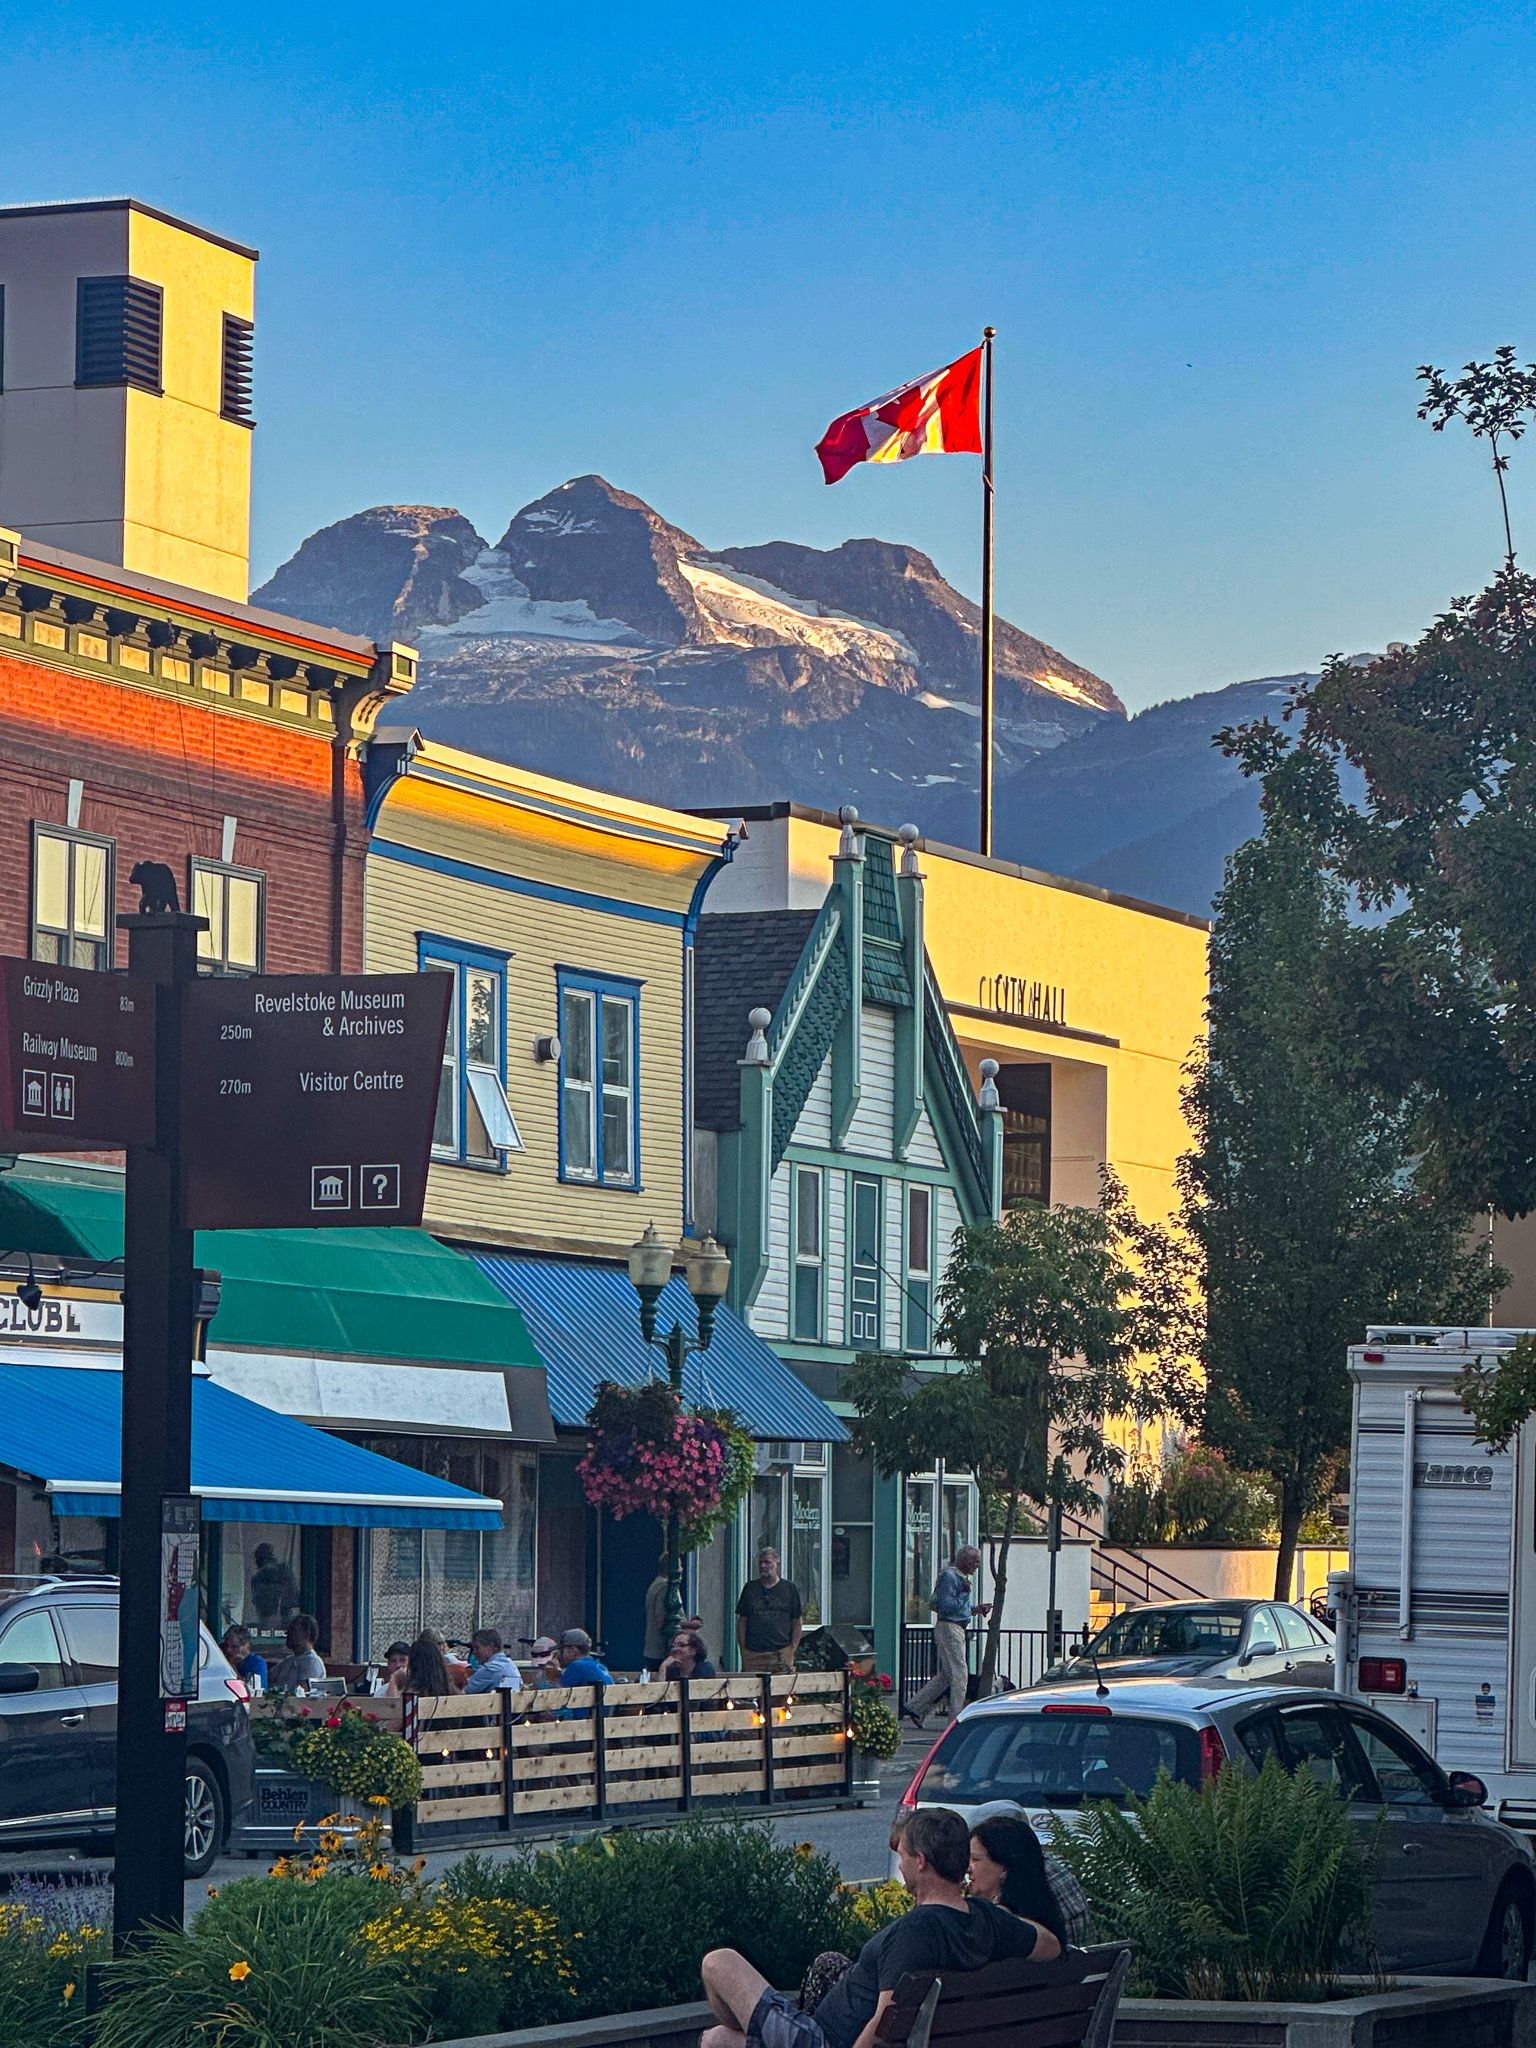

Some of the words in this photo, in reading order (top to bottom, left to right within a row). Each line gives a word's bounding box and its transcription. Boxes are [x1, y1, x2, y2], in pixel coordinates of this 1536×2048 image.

[23, 975, 53, 1003] Grizzly
[55, 980, 79, 1003] Plaza
[255, 991, 336, 1013] Revelstoke
[340, 990, 405, 1010] Museum
[1032, 981, 1067, 1027] HALL
[220, 1024, 252, 1040] 250m
[322, 1016, 334, 1037] &
[339, 1015, 404, 1036] Archives
[23, 1032, 58, 1060] Railway
[60, 1037, 97, 1062] Museum
[219, 1079, 251, 1095] 270m
[300, 1071, 348, 1092] Visitor
[353, 1069, 404, 1091] Centre
[1413, 1462, 1493, 1490] Lance
[261, 1787, 308, 1800] Behlen
[261, 1800, 308, 1810] COUNTRY
